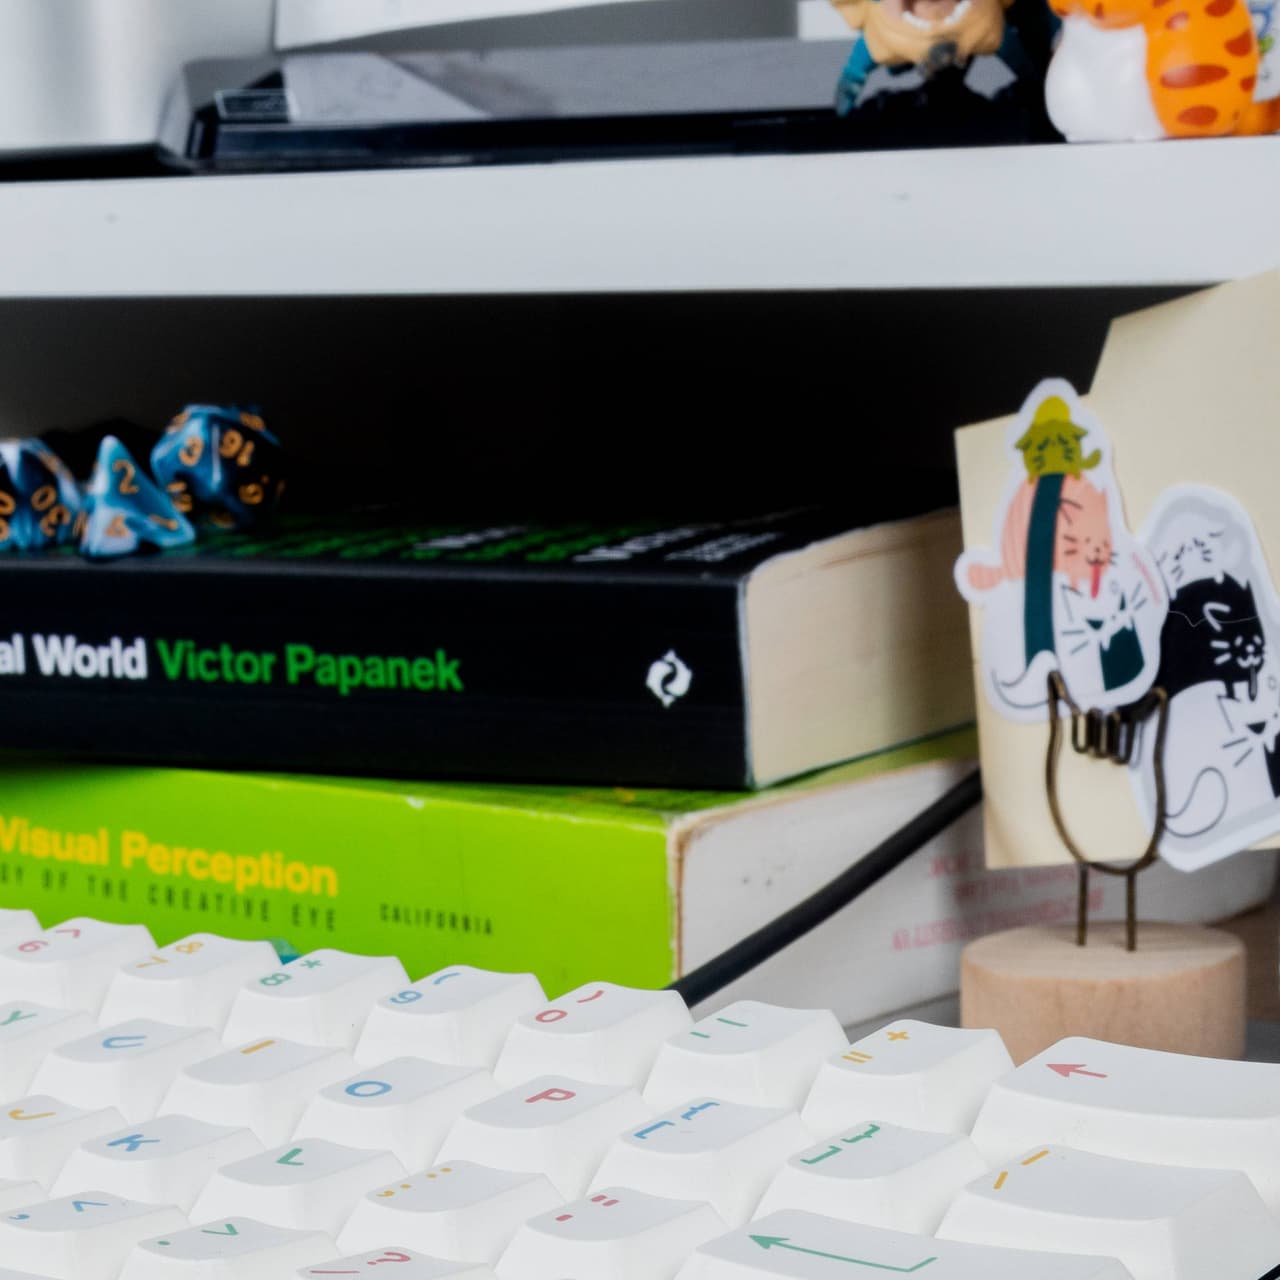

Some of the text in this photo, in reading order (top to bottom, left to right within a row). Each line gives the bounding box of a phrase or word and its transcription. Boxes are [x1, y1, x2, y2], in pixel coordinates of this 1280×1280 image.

[32, 634, 148, 679] World
[156, 639, 464, 695] Victor Papanek
[121, 830, 339, 897] Perception
[43, 868, 68, 890] OF
[87, 874, 128, 901] THE
[148, 884, 270, 922] CREATIVE
[292, 903, 337, 931] EYE
[380, 903, 493, 935] CALIFORNIA
[259, 972, 292, 986] 8
[390, 990, 423, 1005] 9
[0, 1009, 37, 1025] Y
[102, 1035, 148, 1050] U
[344, 1080, 393, 1098] O
[526, 1087, 576, 1104] P
[9, 1109, 56, 1121] J
[106, 1133, 160, 1152] K
[276, 1147, 304, 1166] L
